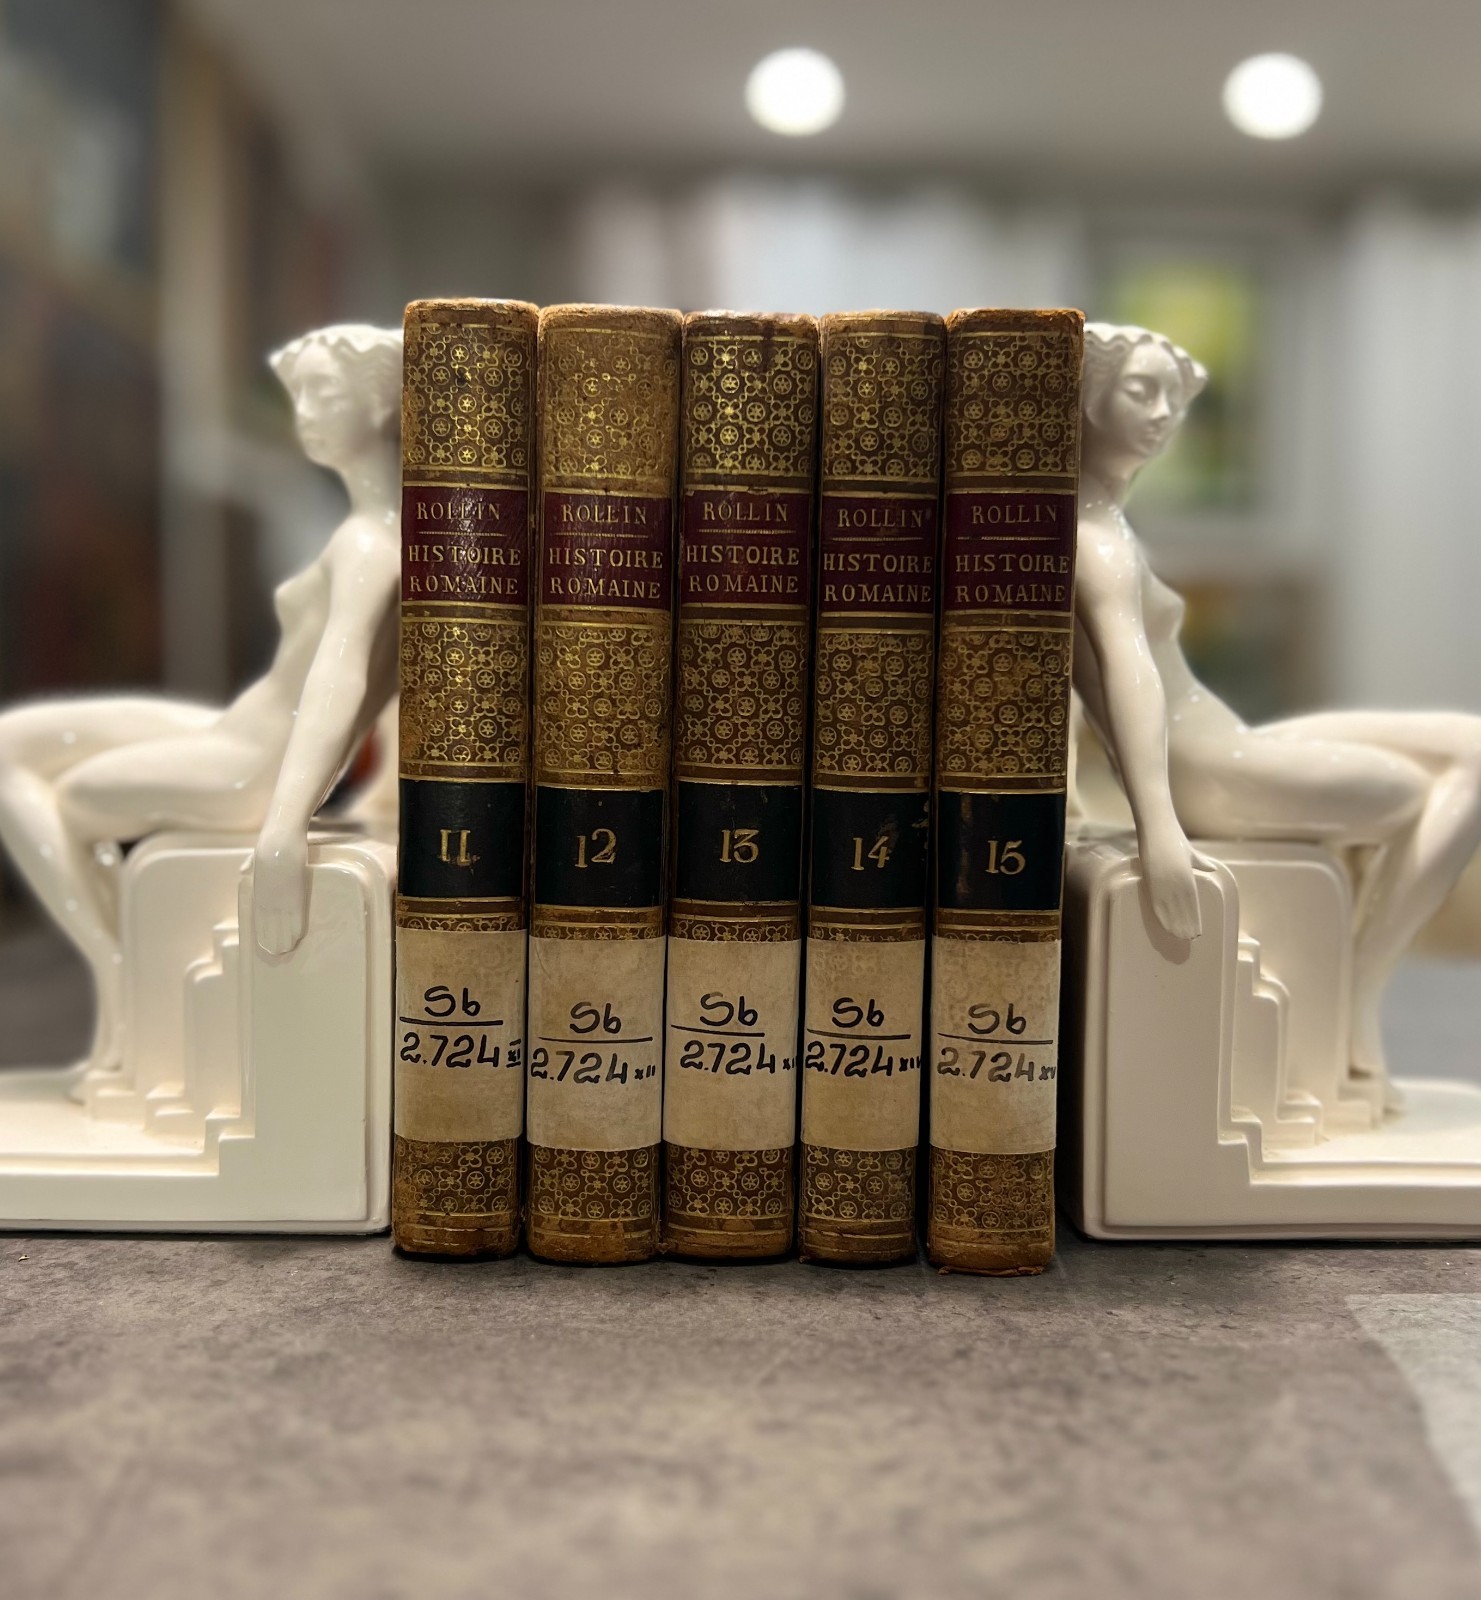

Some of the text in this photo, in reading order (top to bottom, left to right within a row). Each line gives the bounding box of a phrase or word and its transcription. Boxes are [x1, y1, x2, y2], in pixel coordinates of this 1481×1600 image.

[416, 502, 501, 521] ROLLIN
[562, 504, 647, 525] ROLLIN
[703, 502, 789, 522] ROLLIN
[837, 508, 923, 528] ROLLIN
[971, 504, 1058, 524] ROLLIN
[408, 545, 521, 566] HISTOIRE
[549, 549, 663, 569] HISTOIRE
[686, 545, 800, 566] HISTOIRE
[824, 553, 933, 574] HISTOIRE
[955, 554, 1070, 574] HISTOIRE
[409, 575, 519, 595] ROMAINE
[549, 577, 661, 599] ROMAINE
[689, 574, 799, 593] ROMAINE
[824, 584, 931, 603] ROMAINE
[956, 585, 1066, 603] ROMAINE
[575, 828, 618, 868] 12
[719, 828, 760, 863] 13
[850, 836, 890, 871] 14
[984, 839, 1026, 875] 15
[424, 985, 481, 1017] Sb
[699, 991, 758, 1027] Sb
[569, 1002, 622, 1034] Sb
[832, 997, 885, 1028] Sb
[967, 1002, 1027, 1035] Sb
[400, 1031, 500, 1068] 2.724
[680, 1039, 776, 1075] 2.724
[805, 1040, 893, 1078] 2.724
[530, 1047, 628, 1084] 2.724
[937, 1047, 1035, 1082] 2.724
